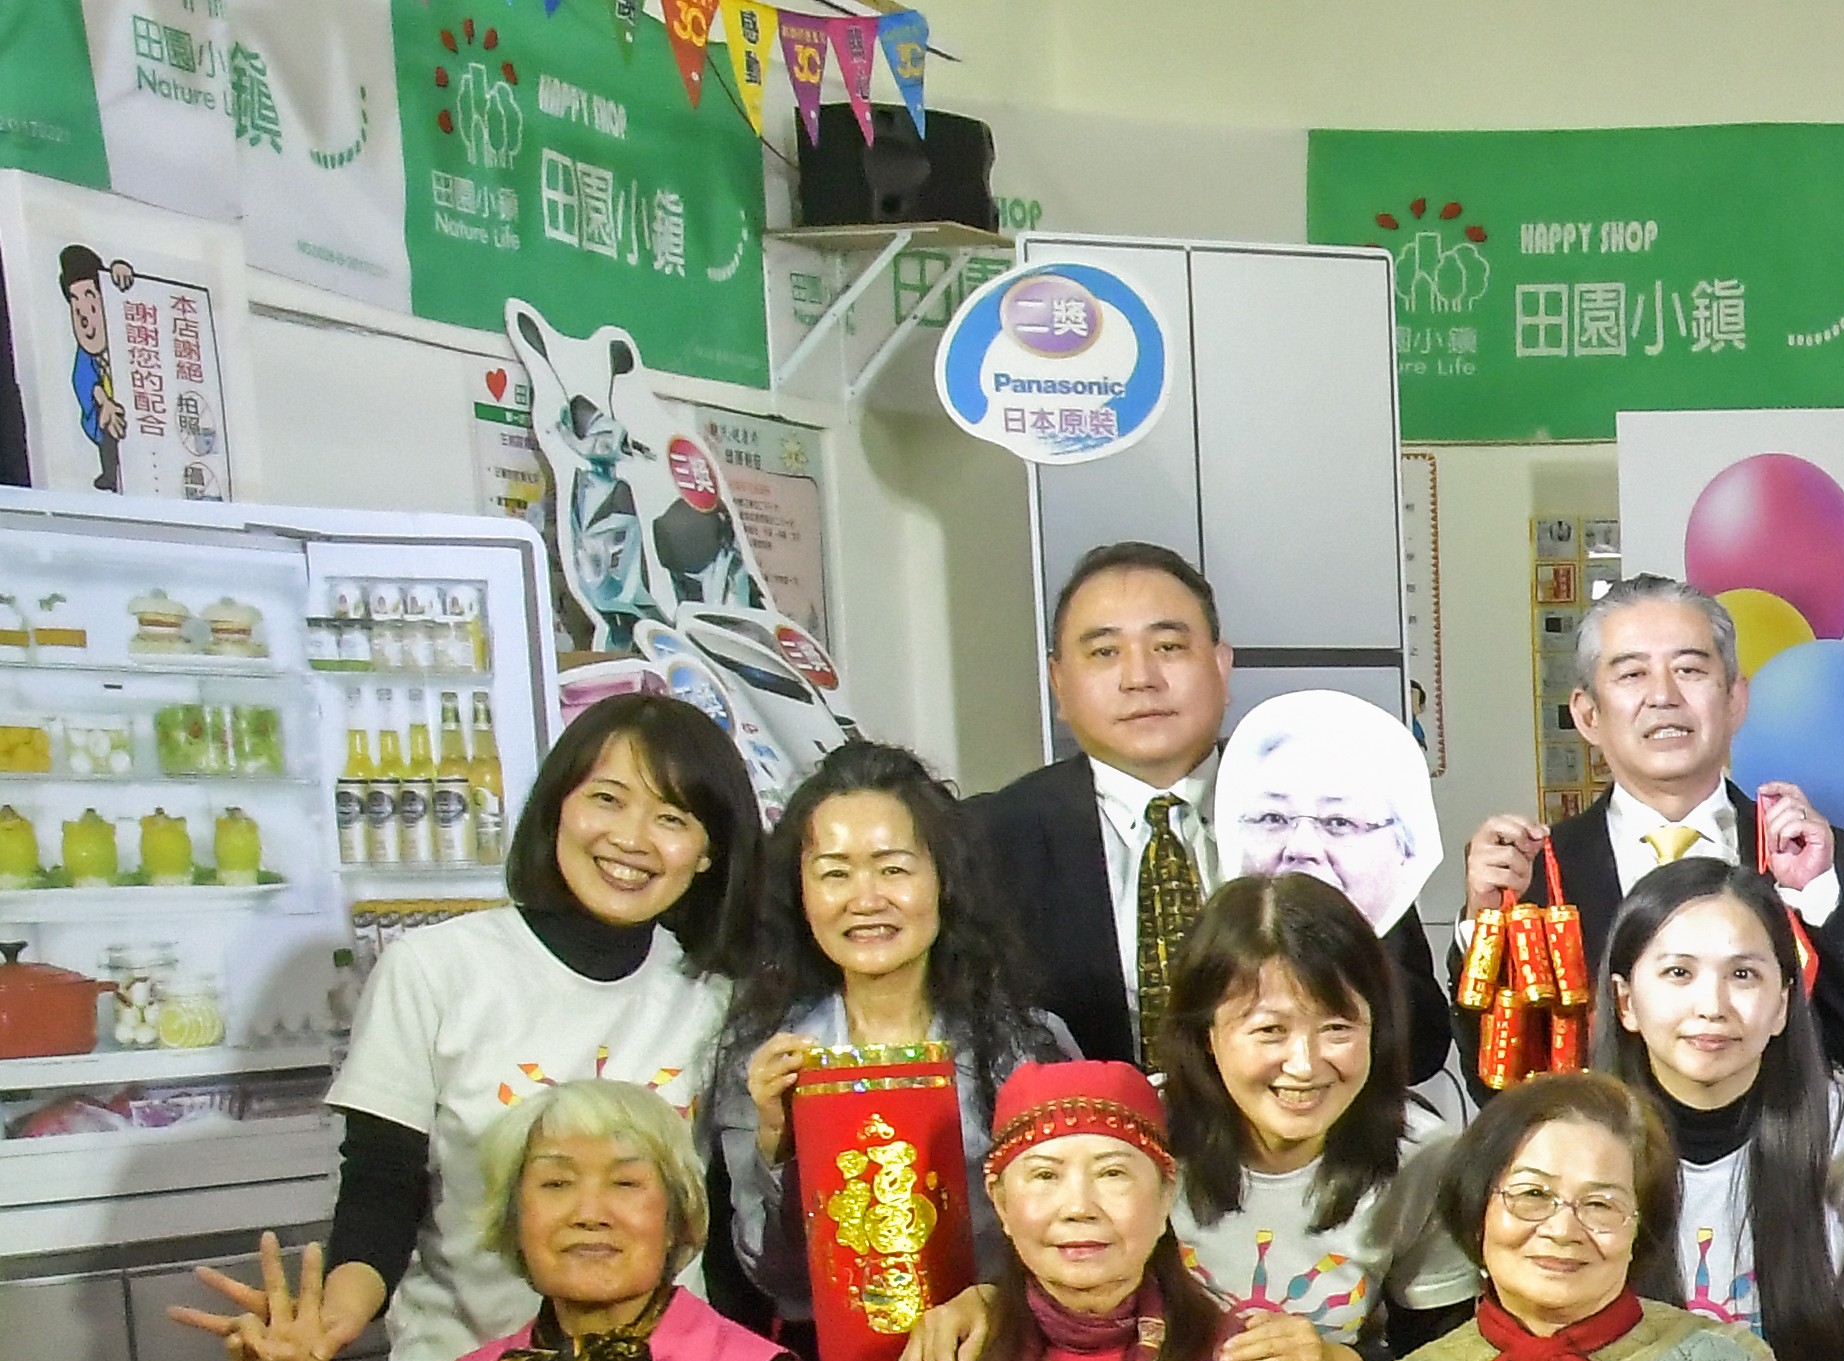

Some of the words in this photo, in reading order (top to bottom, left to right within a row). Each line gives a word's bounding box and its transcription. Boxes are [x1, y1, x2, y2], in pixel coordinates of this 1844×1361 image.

[137, 64, 216, 111] Nature
[542, 148, 686, 277] 田園小鎮
[1520, 222, 1593, 254] HAPPY
[1600, 220, 1658, 253] SHOP
[1015, 297, 1089, 338] 二獎
[1515, 278, 1746, 358] 田園小鎮
[993, 371, 1126, 398] Panasonic
[1438, 358, 1476, 377] Life
[1003, 405, 1117, 440] 日本原裝
